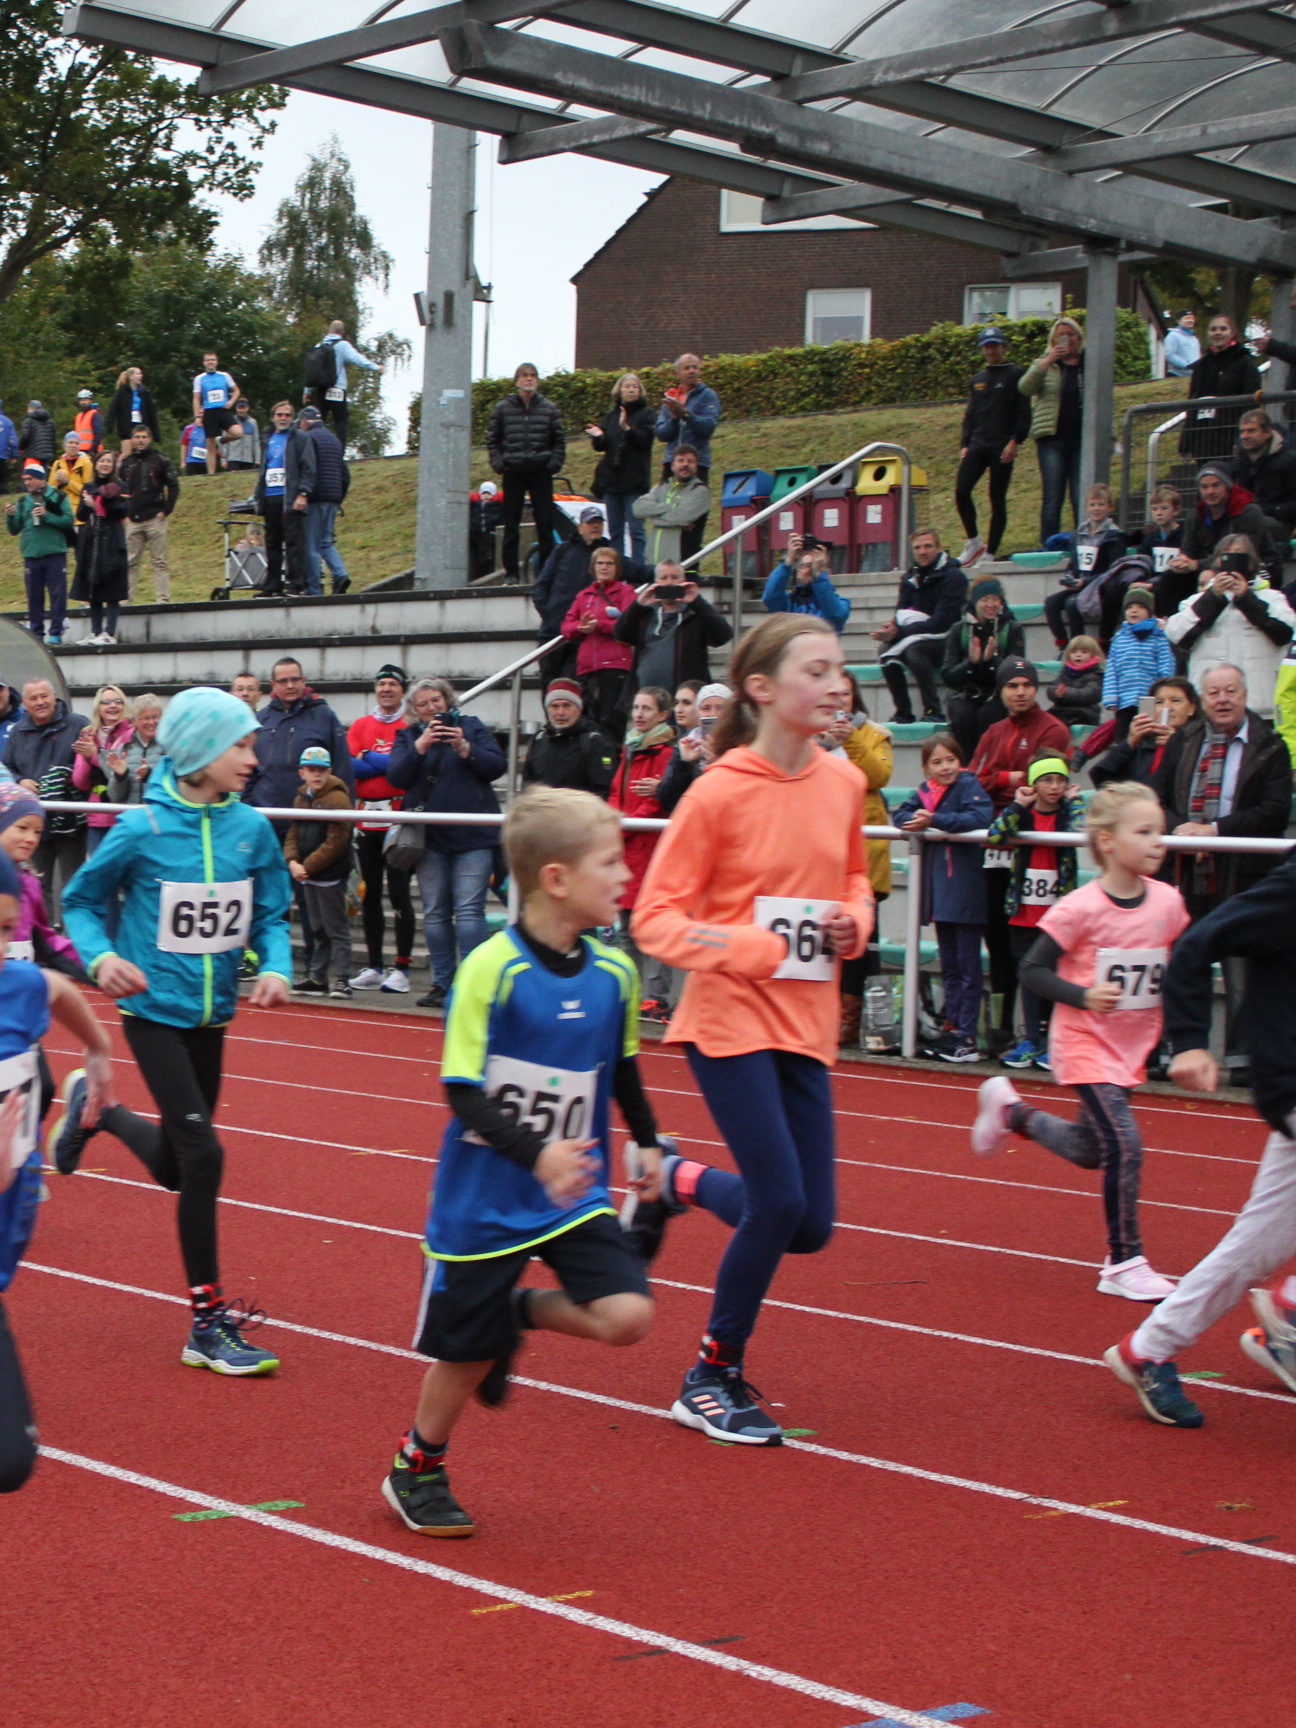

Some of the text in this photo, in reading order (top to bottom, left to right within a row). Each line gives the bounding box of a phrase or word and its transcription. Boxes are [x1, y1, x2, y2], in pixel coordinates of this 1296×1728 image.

[1022, 878, 1062, 898] 384
[172, 900, 242, 939] 652
[496, 1083, 587, 1140] 650
